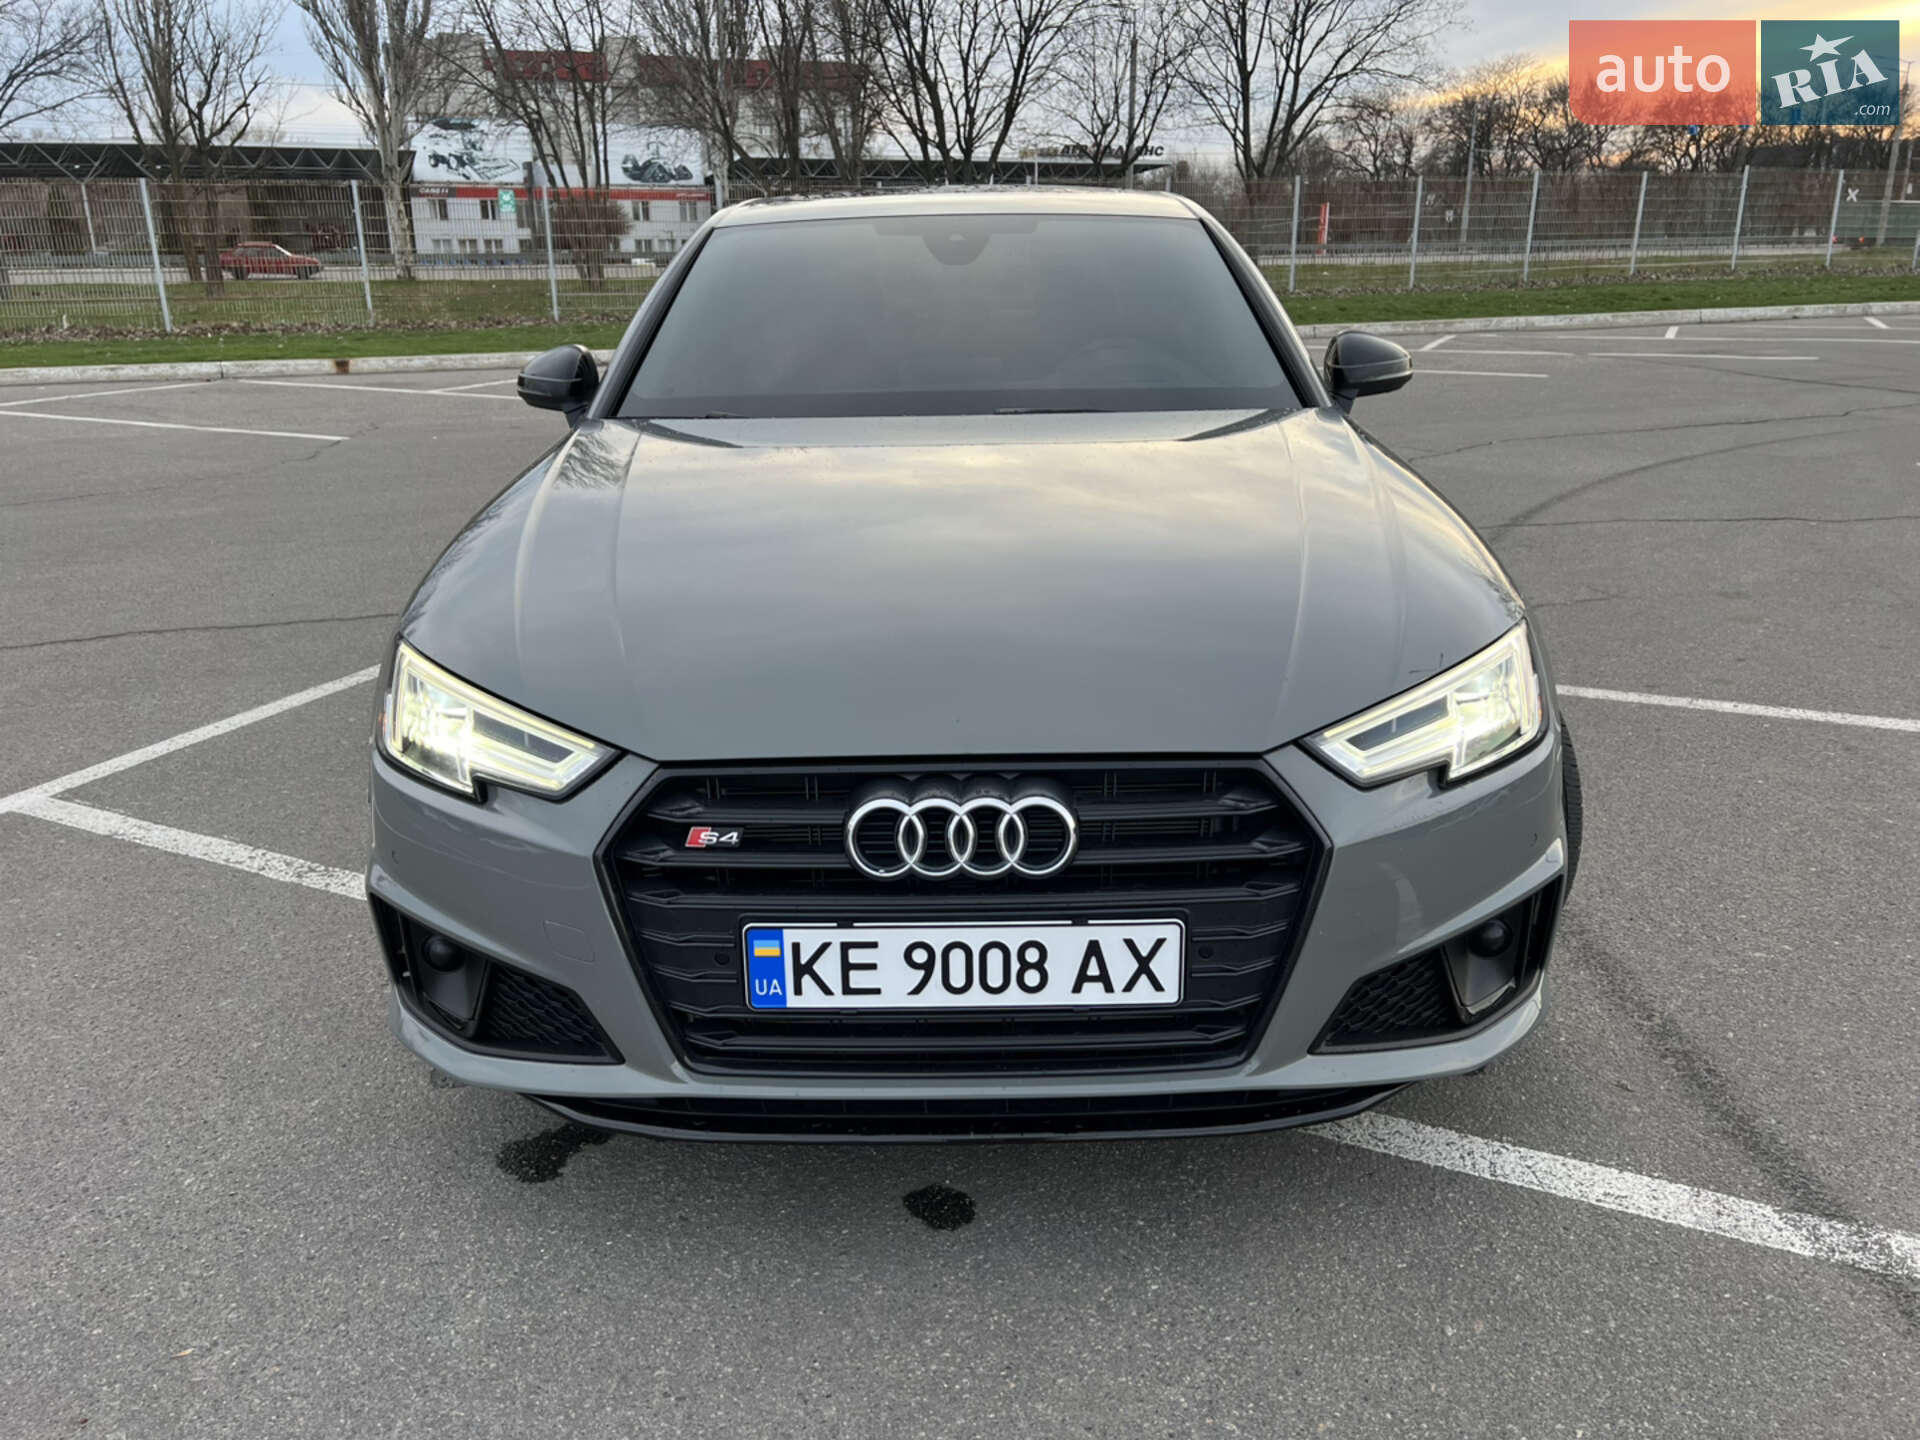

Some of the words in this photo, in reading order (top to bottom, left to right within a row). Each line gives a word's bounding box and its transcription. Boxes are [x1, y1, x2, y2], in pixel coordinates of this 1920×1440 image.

[698, 831, 739, 845] S4
[791, 941, 882, 996] KE
[903, 940, 1049, 996] 9008
[1071, 938, 1168, 994] AX
[755, 978, 782, 996] UA
